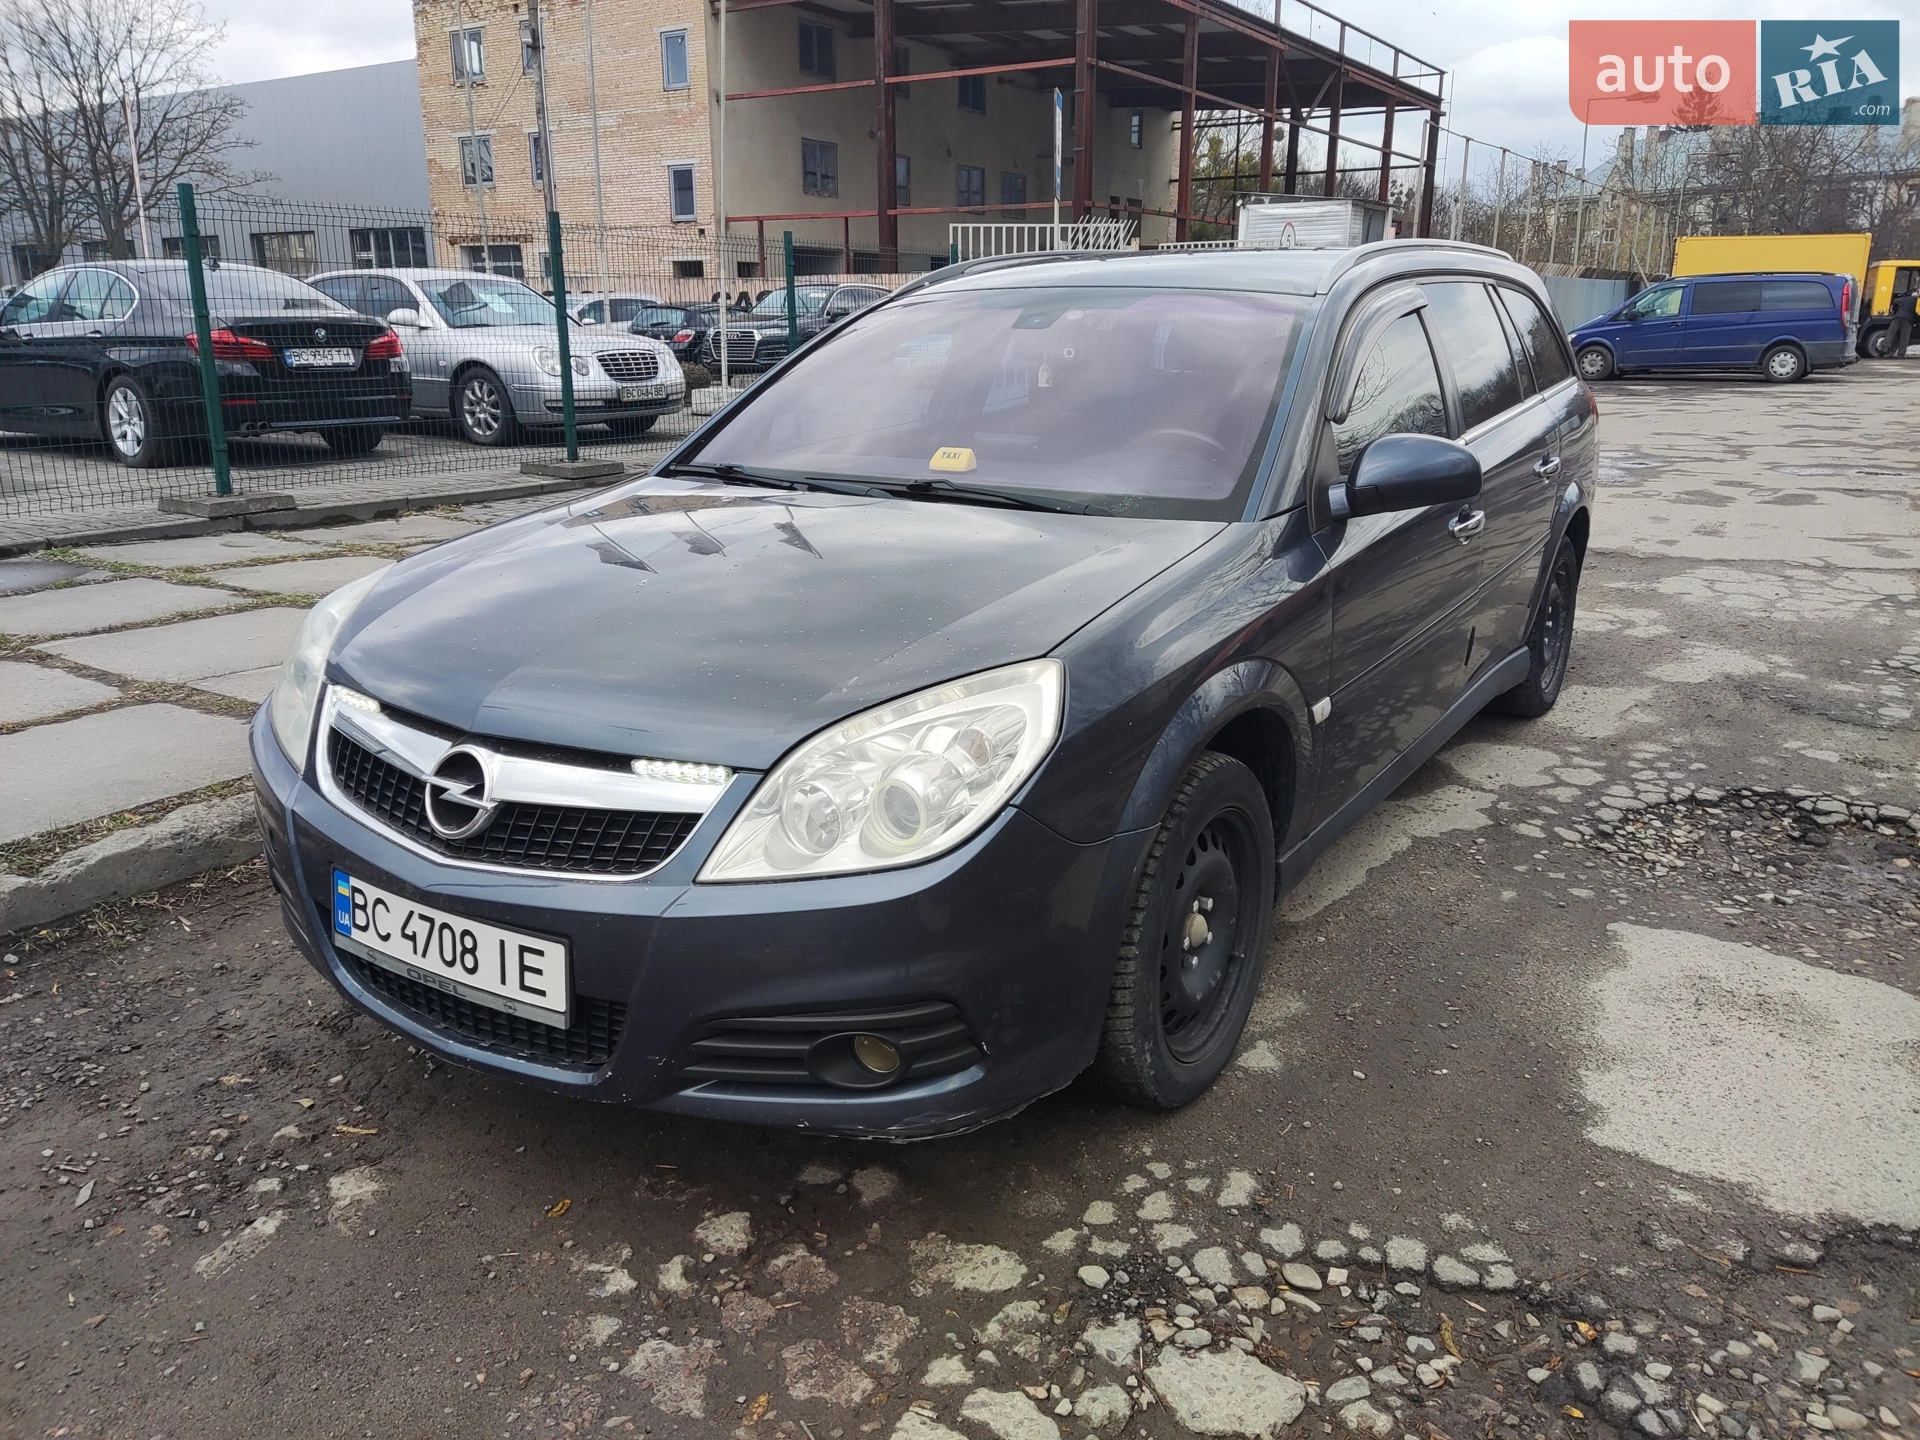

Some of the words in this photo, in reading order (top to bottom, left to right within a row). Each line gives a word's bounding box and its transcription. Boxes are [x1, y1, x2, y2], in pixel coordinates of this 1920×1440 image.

[292, 350, 309, 362] BC
[941, 451, 962, 460] TAXI
[338, 909, 351, 928] UA
[351, 885, 392, 943] BC
[401, 909, 479, 976] 4708
[499, 938, 547, 998] IE
[406, 967, 467, 999] OPEL
